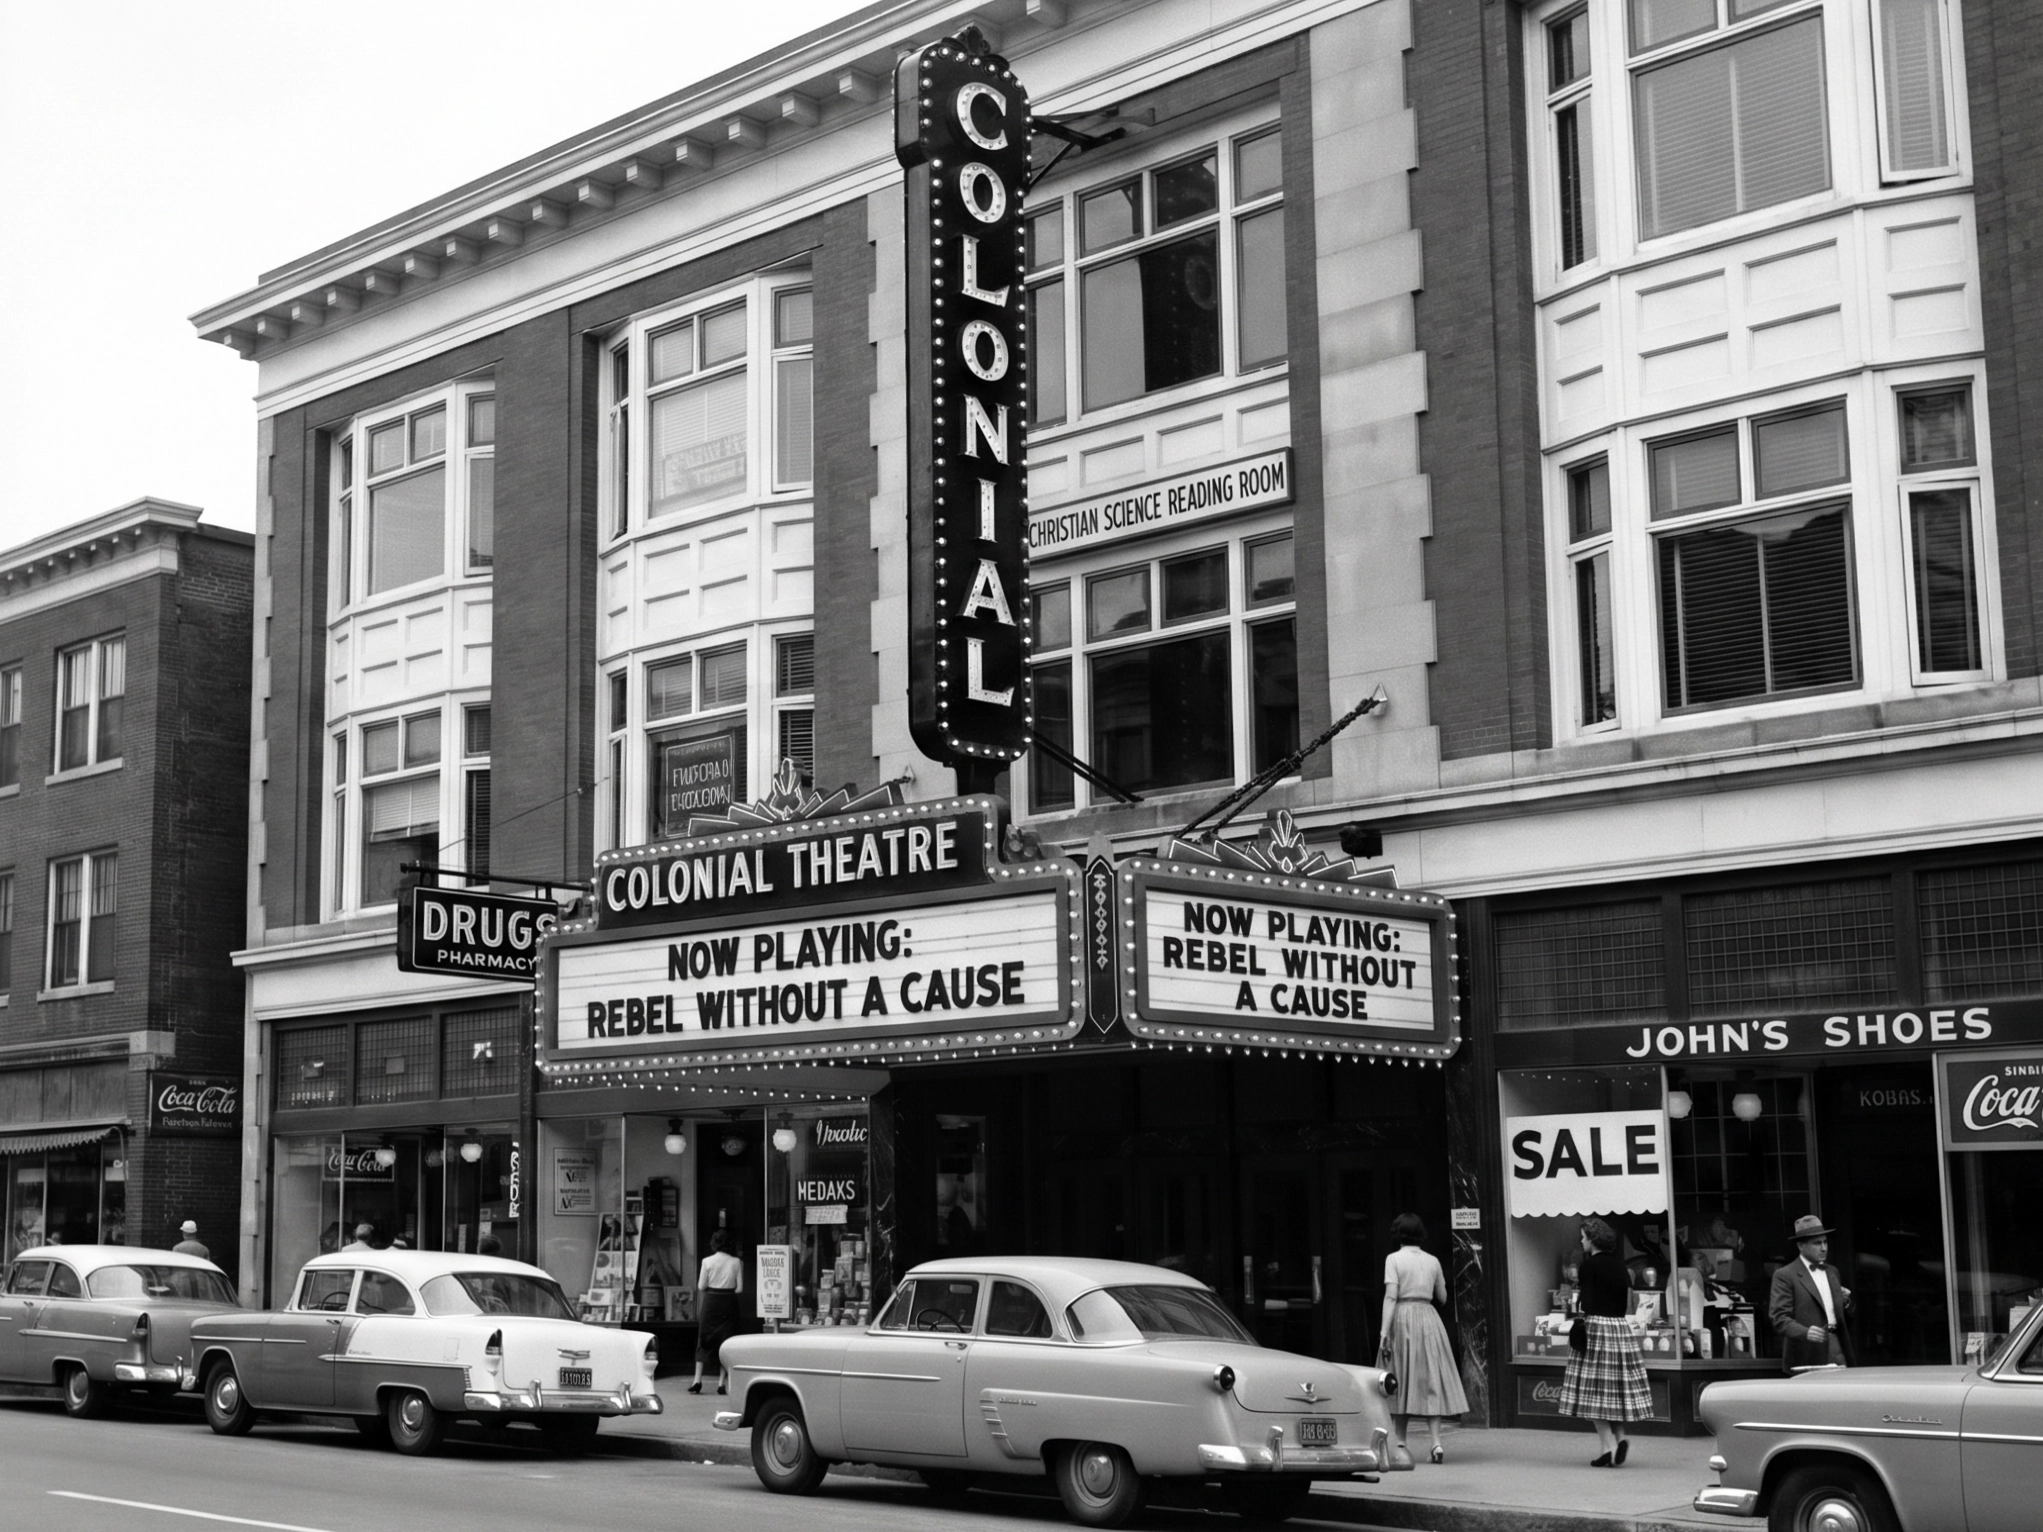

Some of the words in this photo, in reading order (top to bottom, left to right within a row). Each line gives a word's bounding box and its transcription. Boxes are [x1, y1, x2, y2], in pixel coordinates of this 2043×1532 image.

[956, 81, 1017, 707] COLONIAL
[1028, 507, 1098, 548] CHRISTIAN
[1104, 492, 1161, 531] SCIENCE
[1168, 474, 1233, 516] READING
[1239, 461, 1285, 498] ROOM
[606, 849, 774, 912] COLONIAL
[787, 821, 958, 888] THEATRE
[668, 936, 740, 981] NOW
[754, 919, 912, 974] PLAYING:
[1184, 901, 1254, 938] NOW
[1267, 910, 1401, 953] PLAYING:
[1163, 936, 1267, 977] REBEL
[1281, 948, 1416, 989] WITHOUT
[587, 994, 683, 1039] REBEL
[697, 978, 848, 1031] WITHOUT
[861, 976, 888, 1018] A
[900, 961, 1025, 1013] CAUSE
[1235, 980, 1258, 1012] A
[1270, 983, 1368, 1020] CAUSE
[1626, 1020, 1789, 1058] JOHN'S
[1822, 1007, 1992, 1048] SHOES
[1512, 1124, 1660, 1180] SALE
